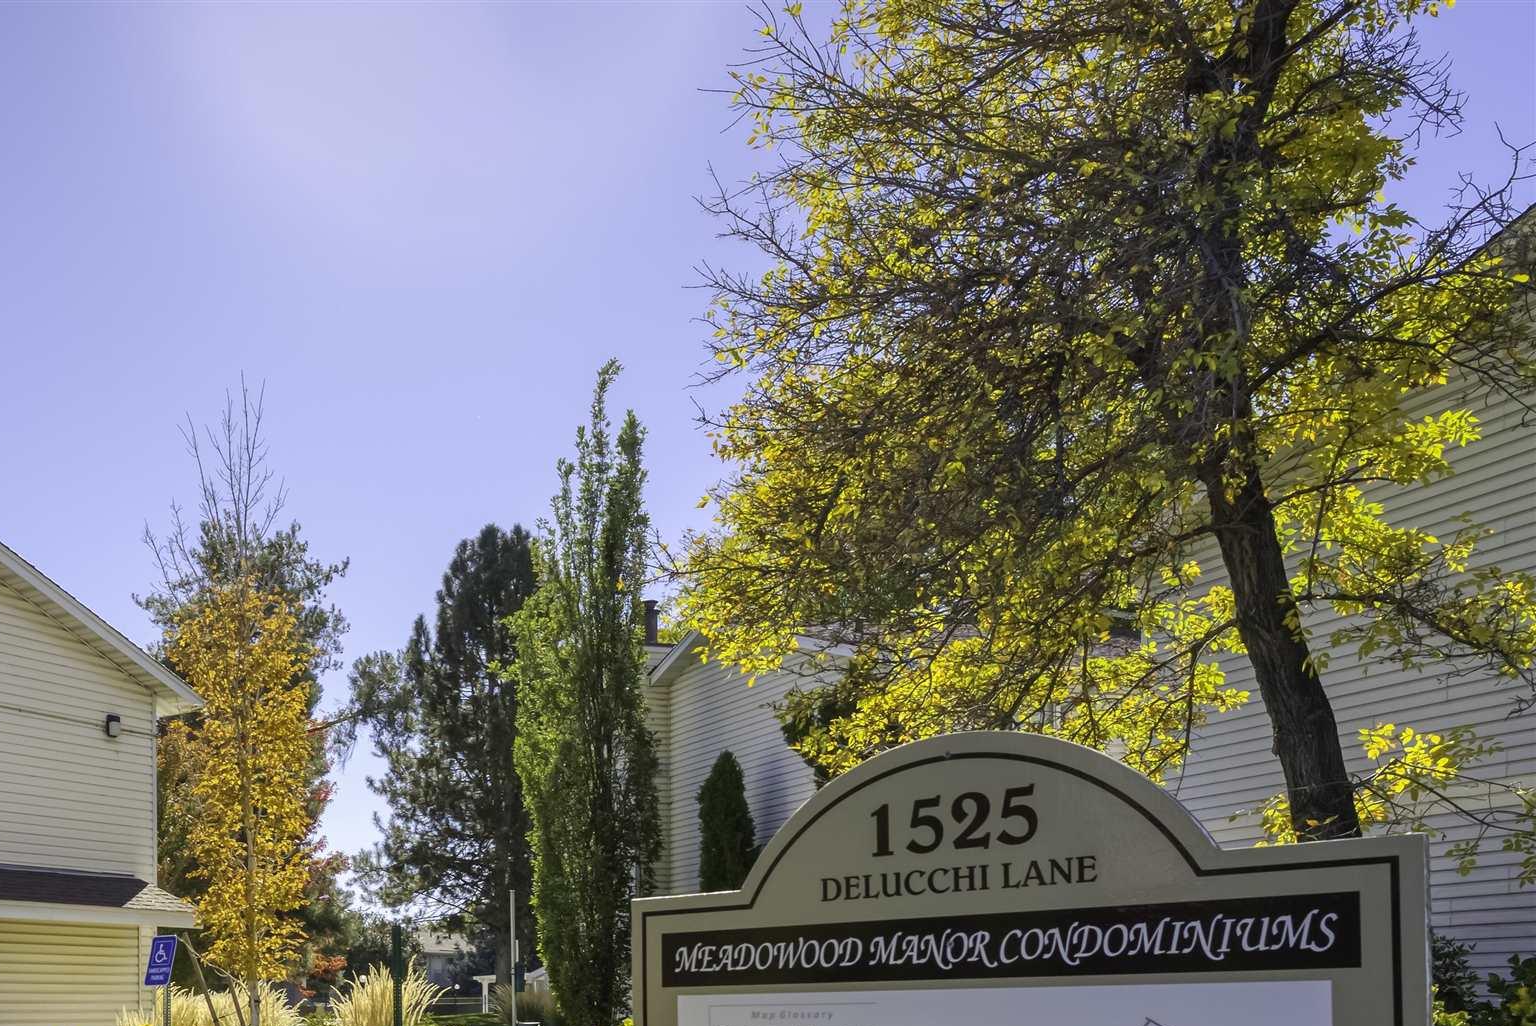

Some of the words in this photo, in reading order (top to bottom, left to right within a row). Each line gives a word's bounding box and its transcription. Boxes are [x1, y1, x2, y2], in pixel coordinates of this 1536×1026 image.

[870, 783, 1039, 858] 1525
[820, 864, 990, 902] DELUCCHI
[1000, 855, 1098, 890] LANE
[674, 937, 863, 973] MEADOWOOD
[869, 929, 997, 970] MANOR
[998, 909, 1339, 965] CONDOMINIUMS
[751, 1010, 776, 1021] Map
[779, 1009, 833, 1021] Glossary
